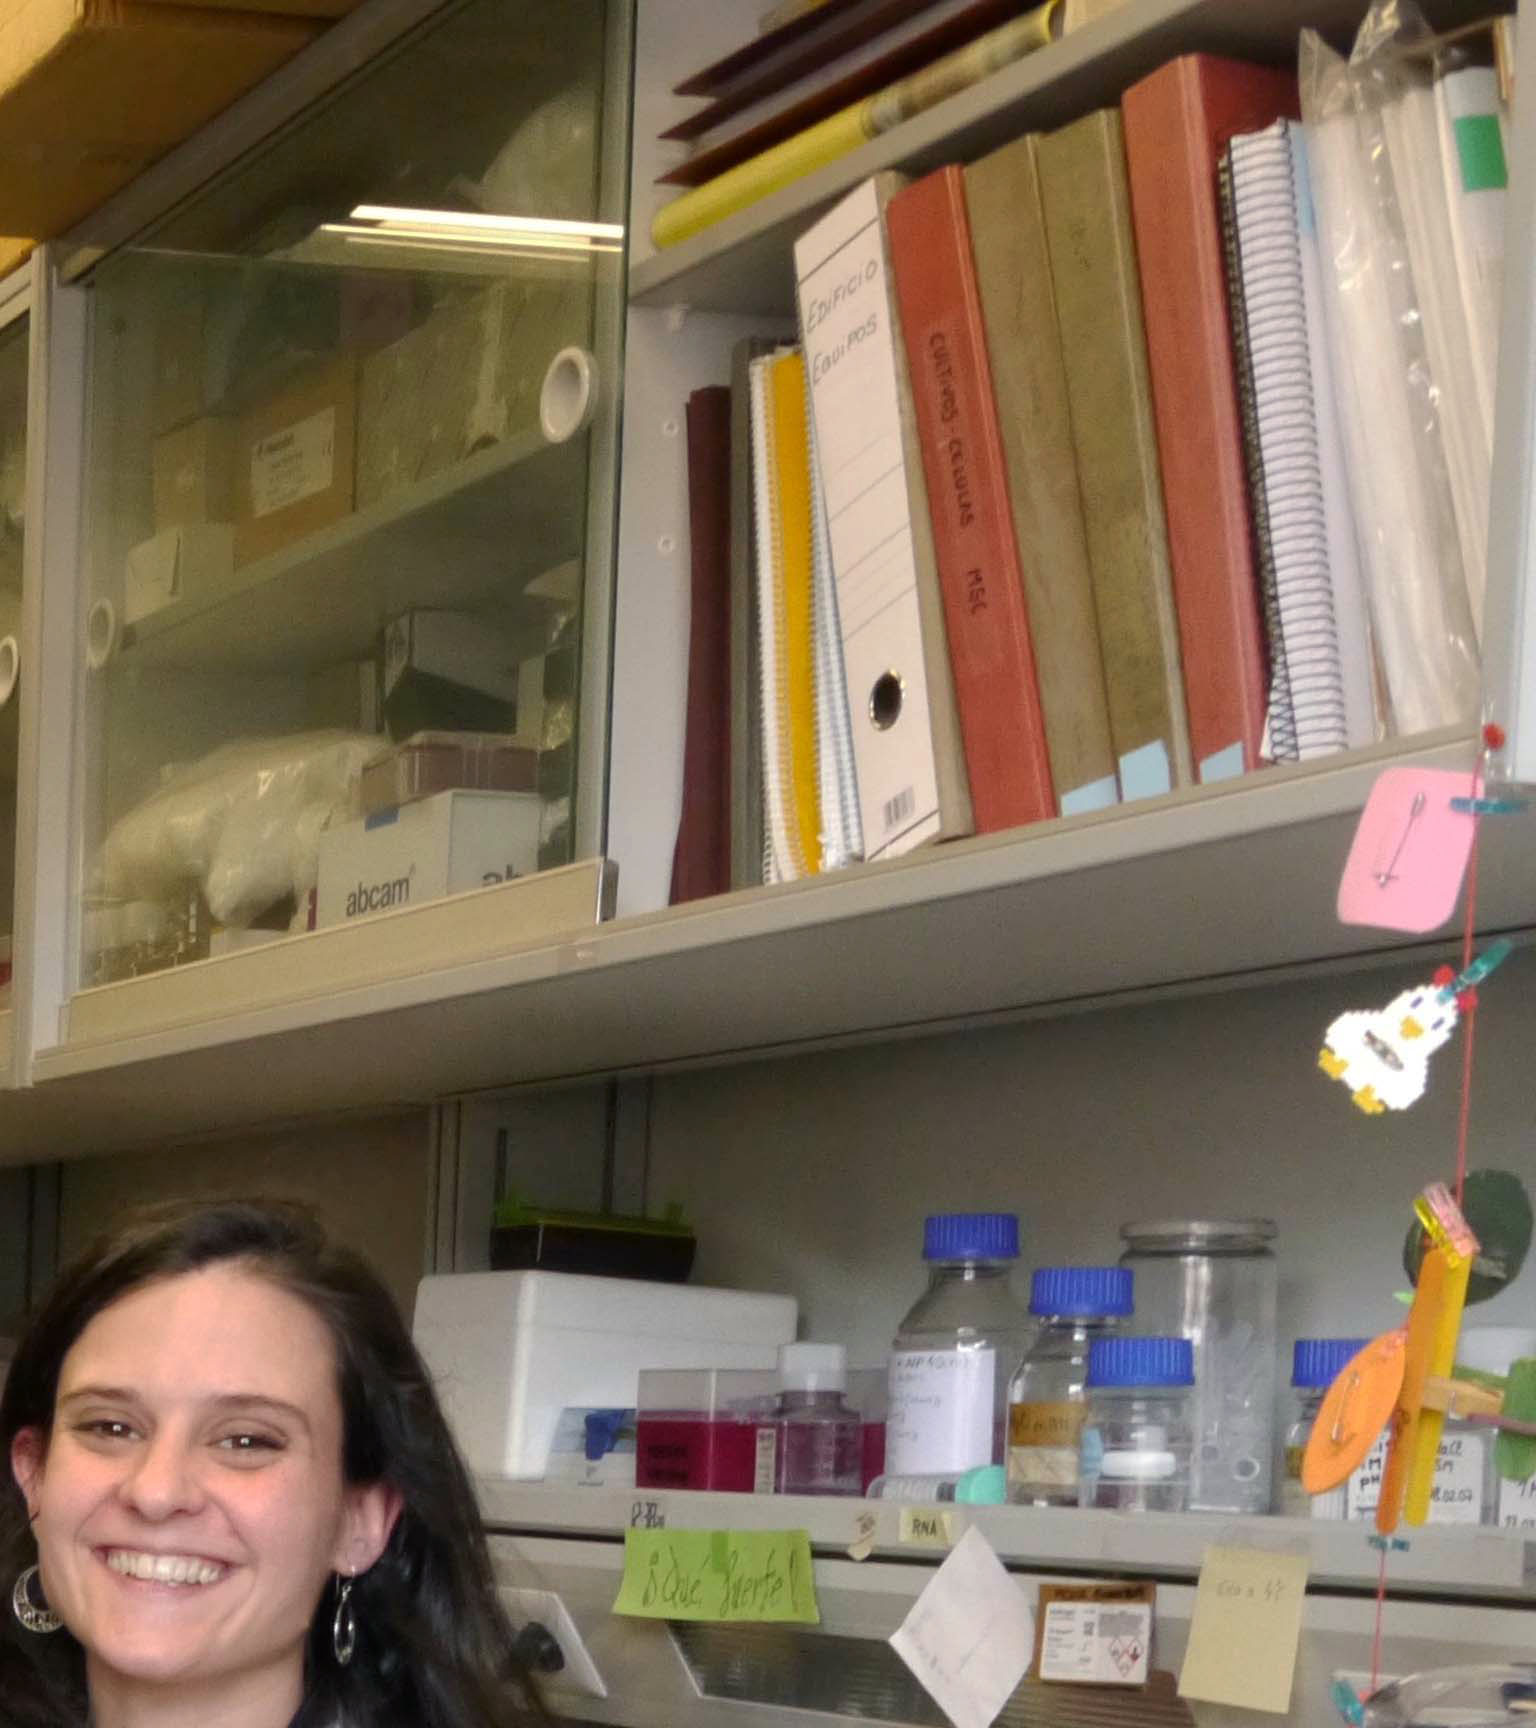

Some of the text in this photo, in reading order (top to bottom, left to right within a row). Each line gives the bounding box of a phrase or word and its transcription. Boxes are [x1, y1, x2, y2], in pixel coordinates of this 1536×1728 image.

[805, 258, 878, 335] EDIFICIO
[812, 312, 878, 386] EQUIPOS
[346, 876, 410, 917] abcam
[911, 1517, 938, 1538] RNA
